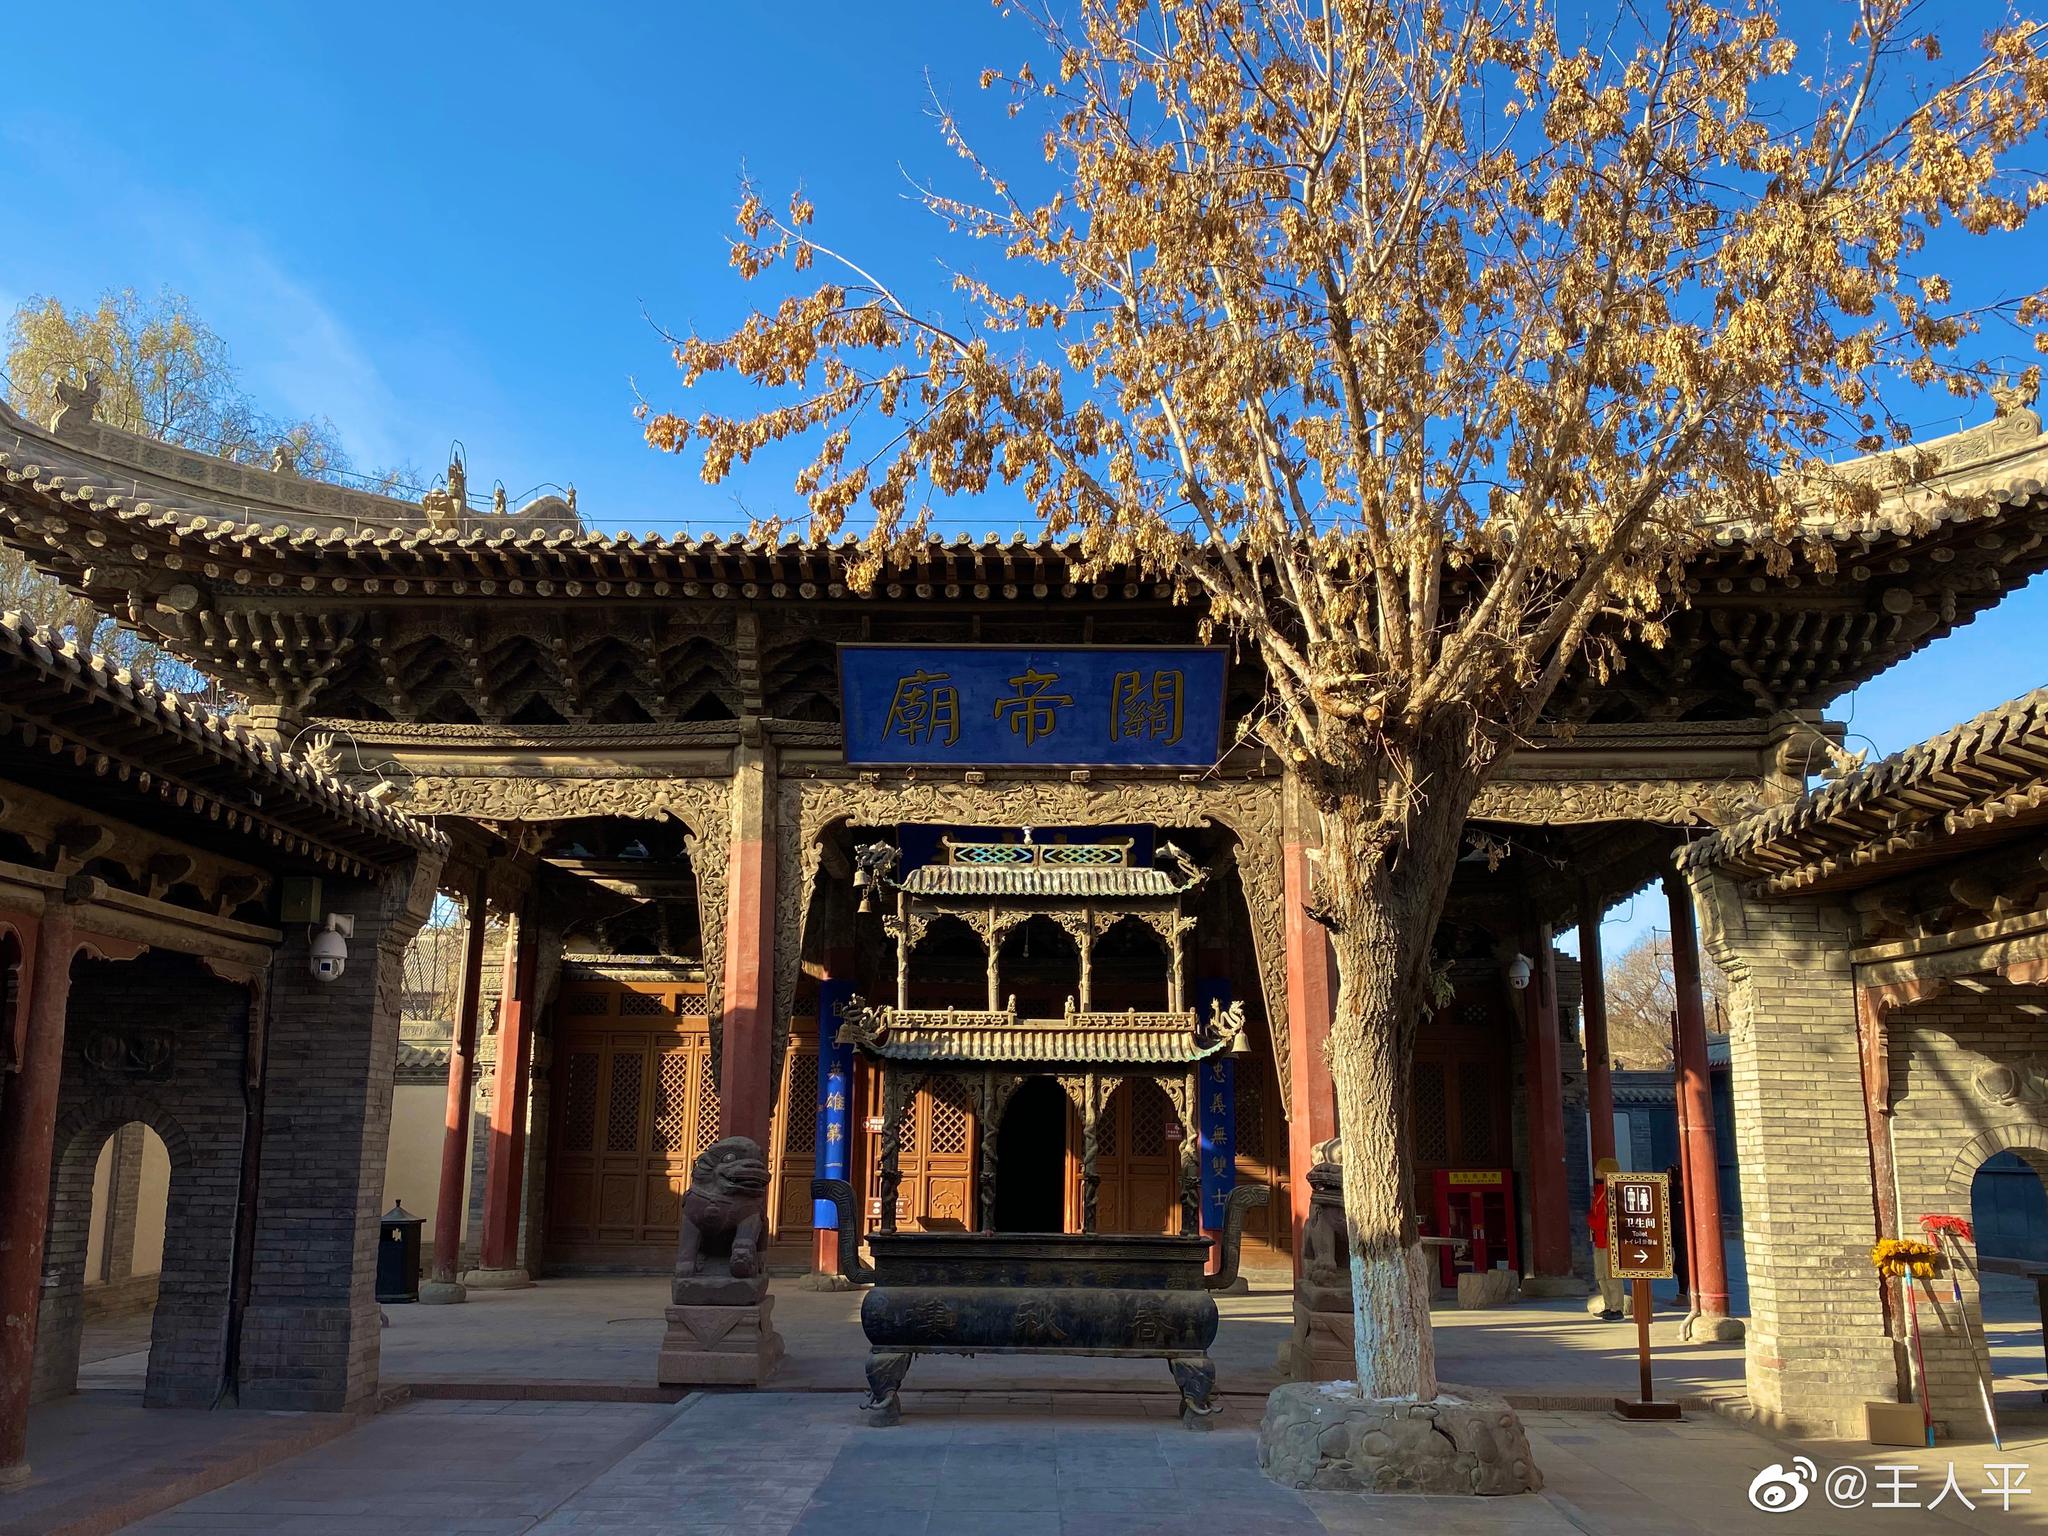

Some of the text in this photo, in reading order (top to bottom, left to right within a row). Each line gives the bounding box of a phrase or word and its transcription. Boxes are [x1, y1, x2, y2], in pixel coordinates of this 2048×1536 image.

[1209, 1061, 1228, 1208] 忠義無雙士
[1625, 1217, 1656, 1229] 卫生间
